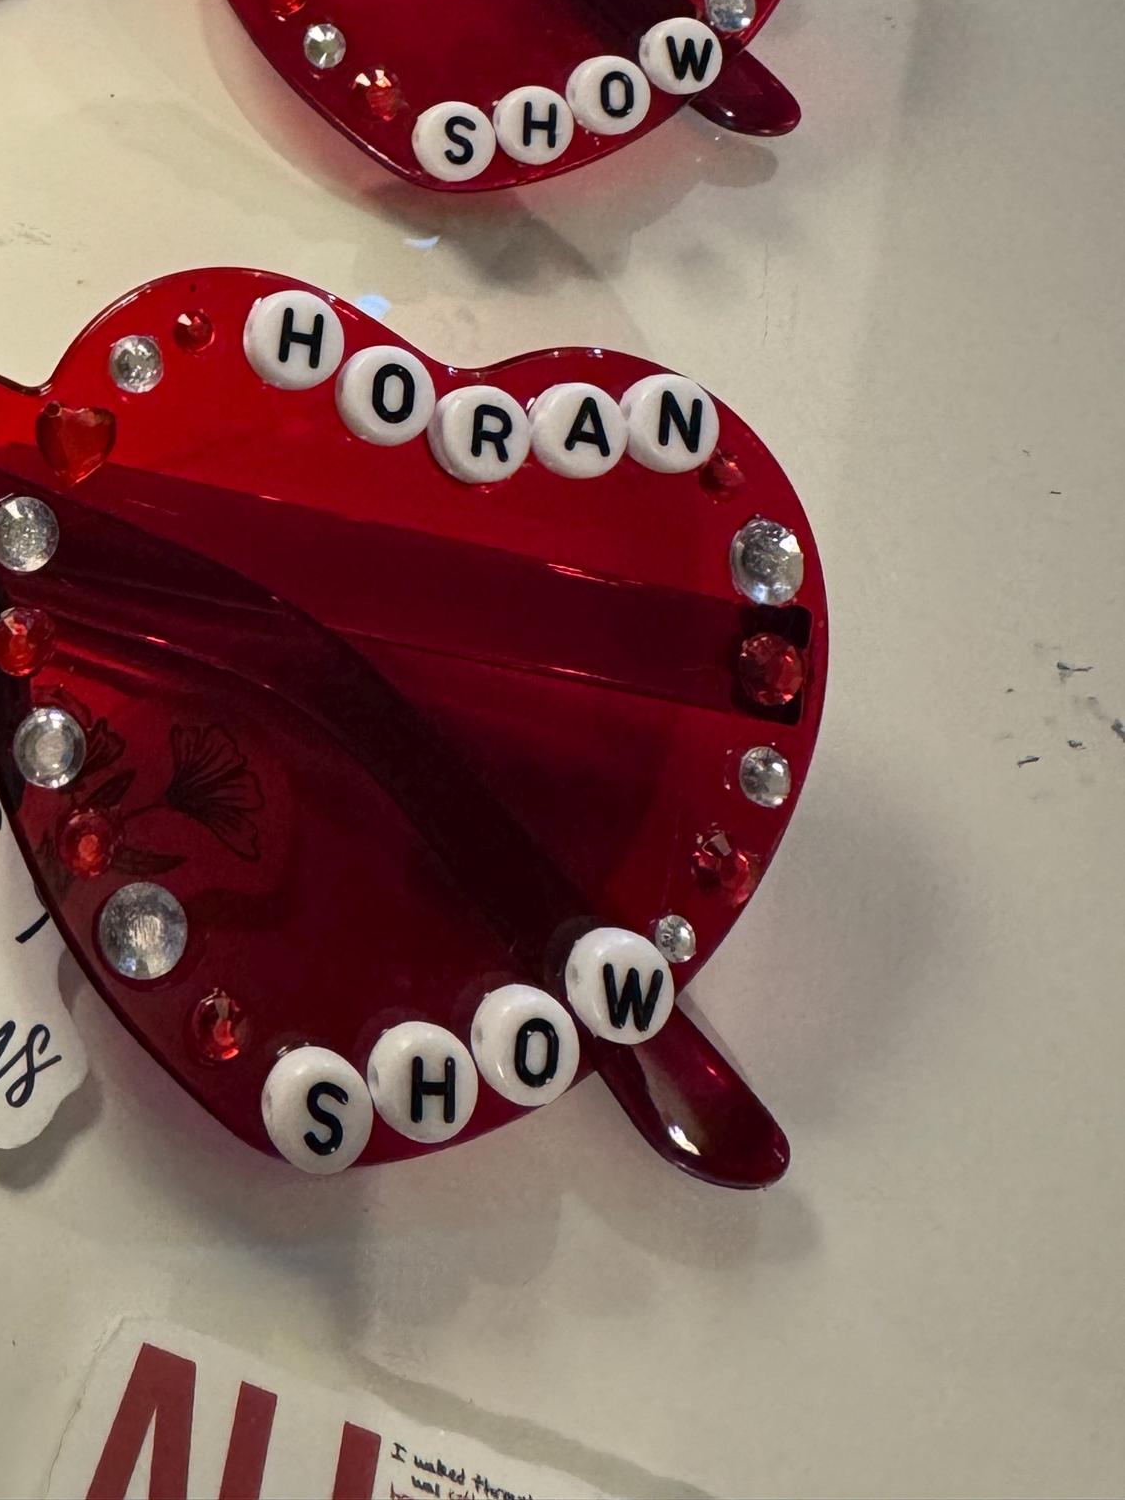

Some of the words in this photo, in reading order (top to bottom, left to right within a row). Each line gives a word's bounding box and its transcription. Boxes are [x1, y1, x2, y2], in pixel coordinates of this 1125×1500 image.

[443, 35, 715, 166] SHOW
[278, 306, 705, 464] HORAN
[302, 961, 665, 1157] SHOW
